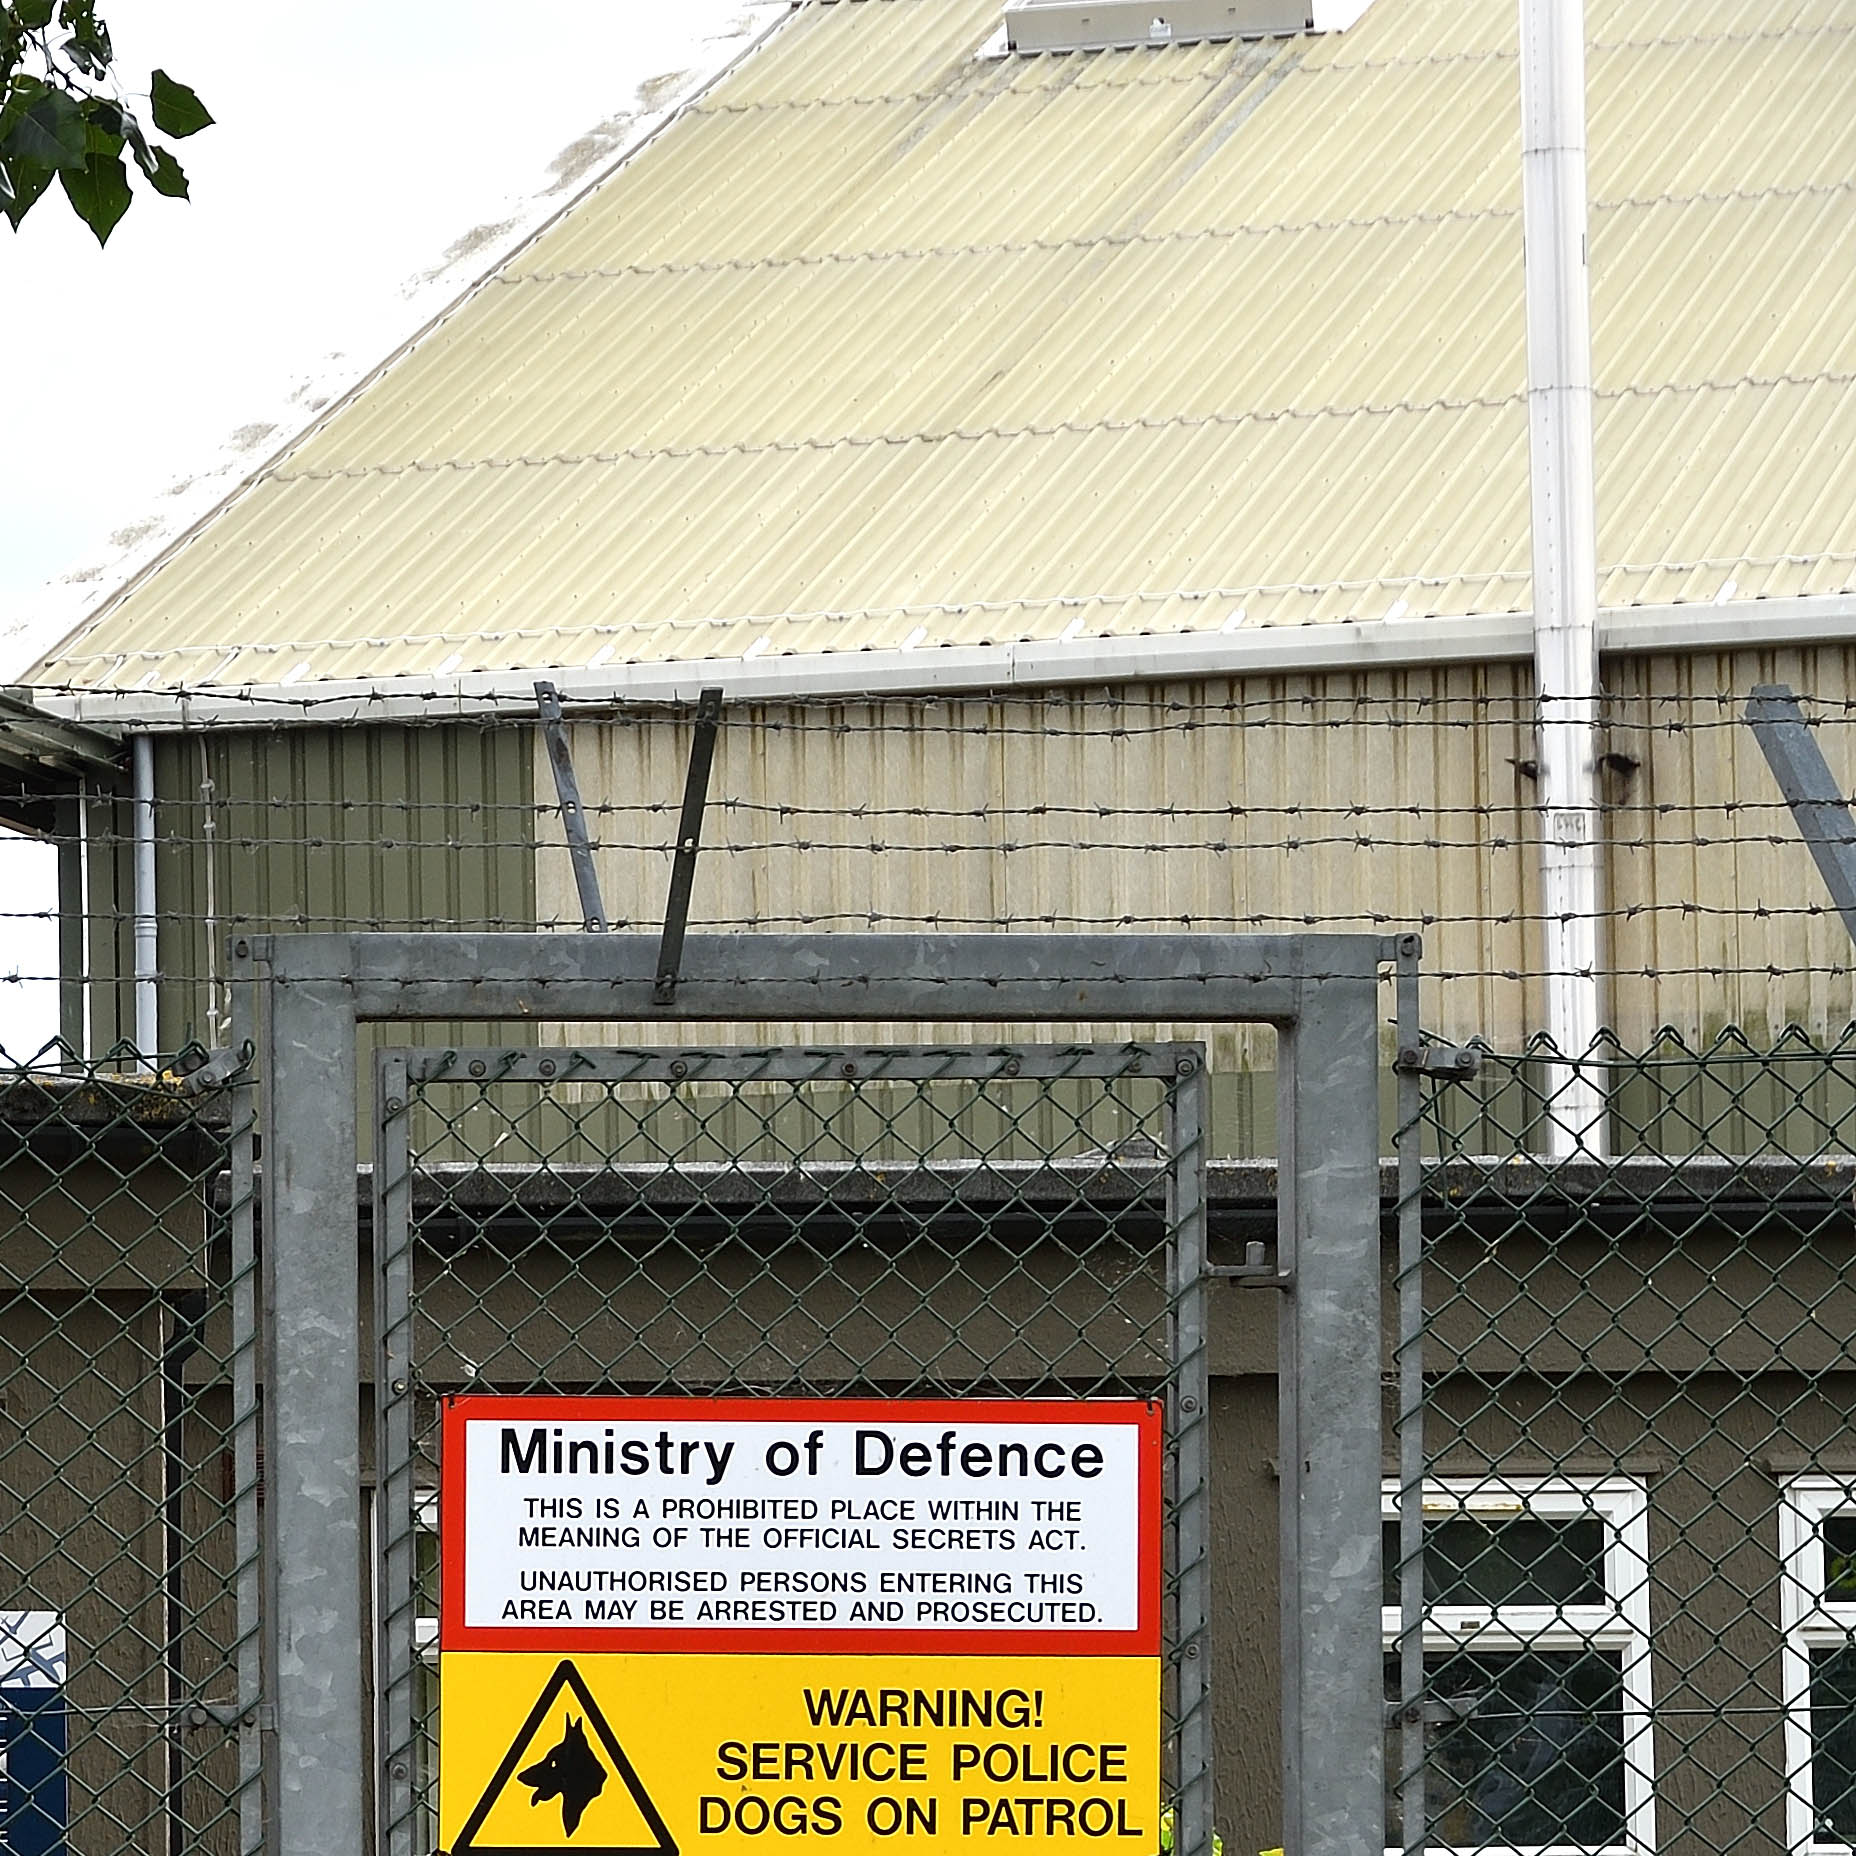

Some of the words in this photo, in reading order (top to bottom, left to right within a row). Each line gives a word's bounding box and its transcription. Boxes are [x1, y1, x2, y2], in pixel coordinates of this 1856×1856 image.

[500, 1428, 735, 1485] Ministry
[765, 1429, 824, 1477] of
[855, 1429, 1104, 1479] Defence
[523, 1497, 583, 1519] THIS
[596, 1497, 620, 1519] IS
[632, 1498, 650, 1519] A
[662, 1498, 818, 1520] PROHIBITED
[831, 1499, 915, 1521] PLACE
[927, 1500, 1019, 1521] WITHIN
[1030, 1500, 1082, 1522] THE
[518, 1526, 640, 1548] MEANING
[652, 1526, 689, 1548] OF
[699, 1527, 750, 1548] THE
[763, 1527, 881, 1549] OFFICIAL
[892, 1528, 1016, 1551] SECRETS
[1028, 1529, 1086, 1551] ACT.
[520, 1570, 728, 1592] UNAUTHORISED
[740, 1571, 867, 1593] PERSONS
[880, 1572, 1012, 1594] ENTERING
[1023, 1573, 1083, 1595] THIS
[501, 1599, 573, 1620] AREA
[585, 1599, 638, 1621] MAY
[650, 1600, 684, 1621] BE
[696, 1600, 837, 1622] ARRESTED
[849, 1601, 904, 1622] AND
[917, 1601, 1103, 1623] PROSECUTED.
[803, 1688, 1043, 1729] WARNING!
[716, 1741, 928, 1782] SERVICE
[952, 1743, 1128, 1783] POLICE
[699, 1795, 842, 1836] DOGS
[866, 1796, 937, 1836] ON
[962, 1797, 1143, 1837] PATROL
